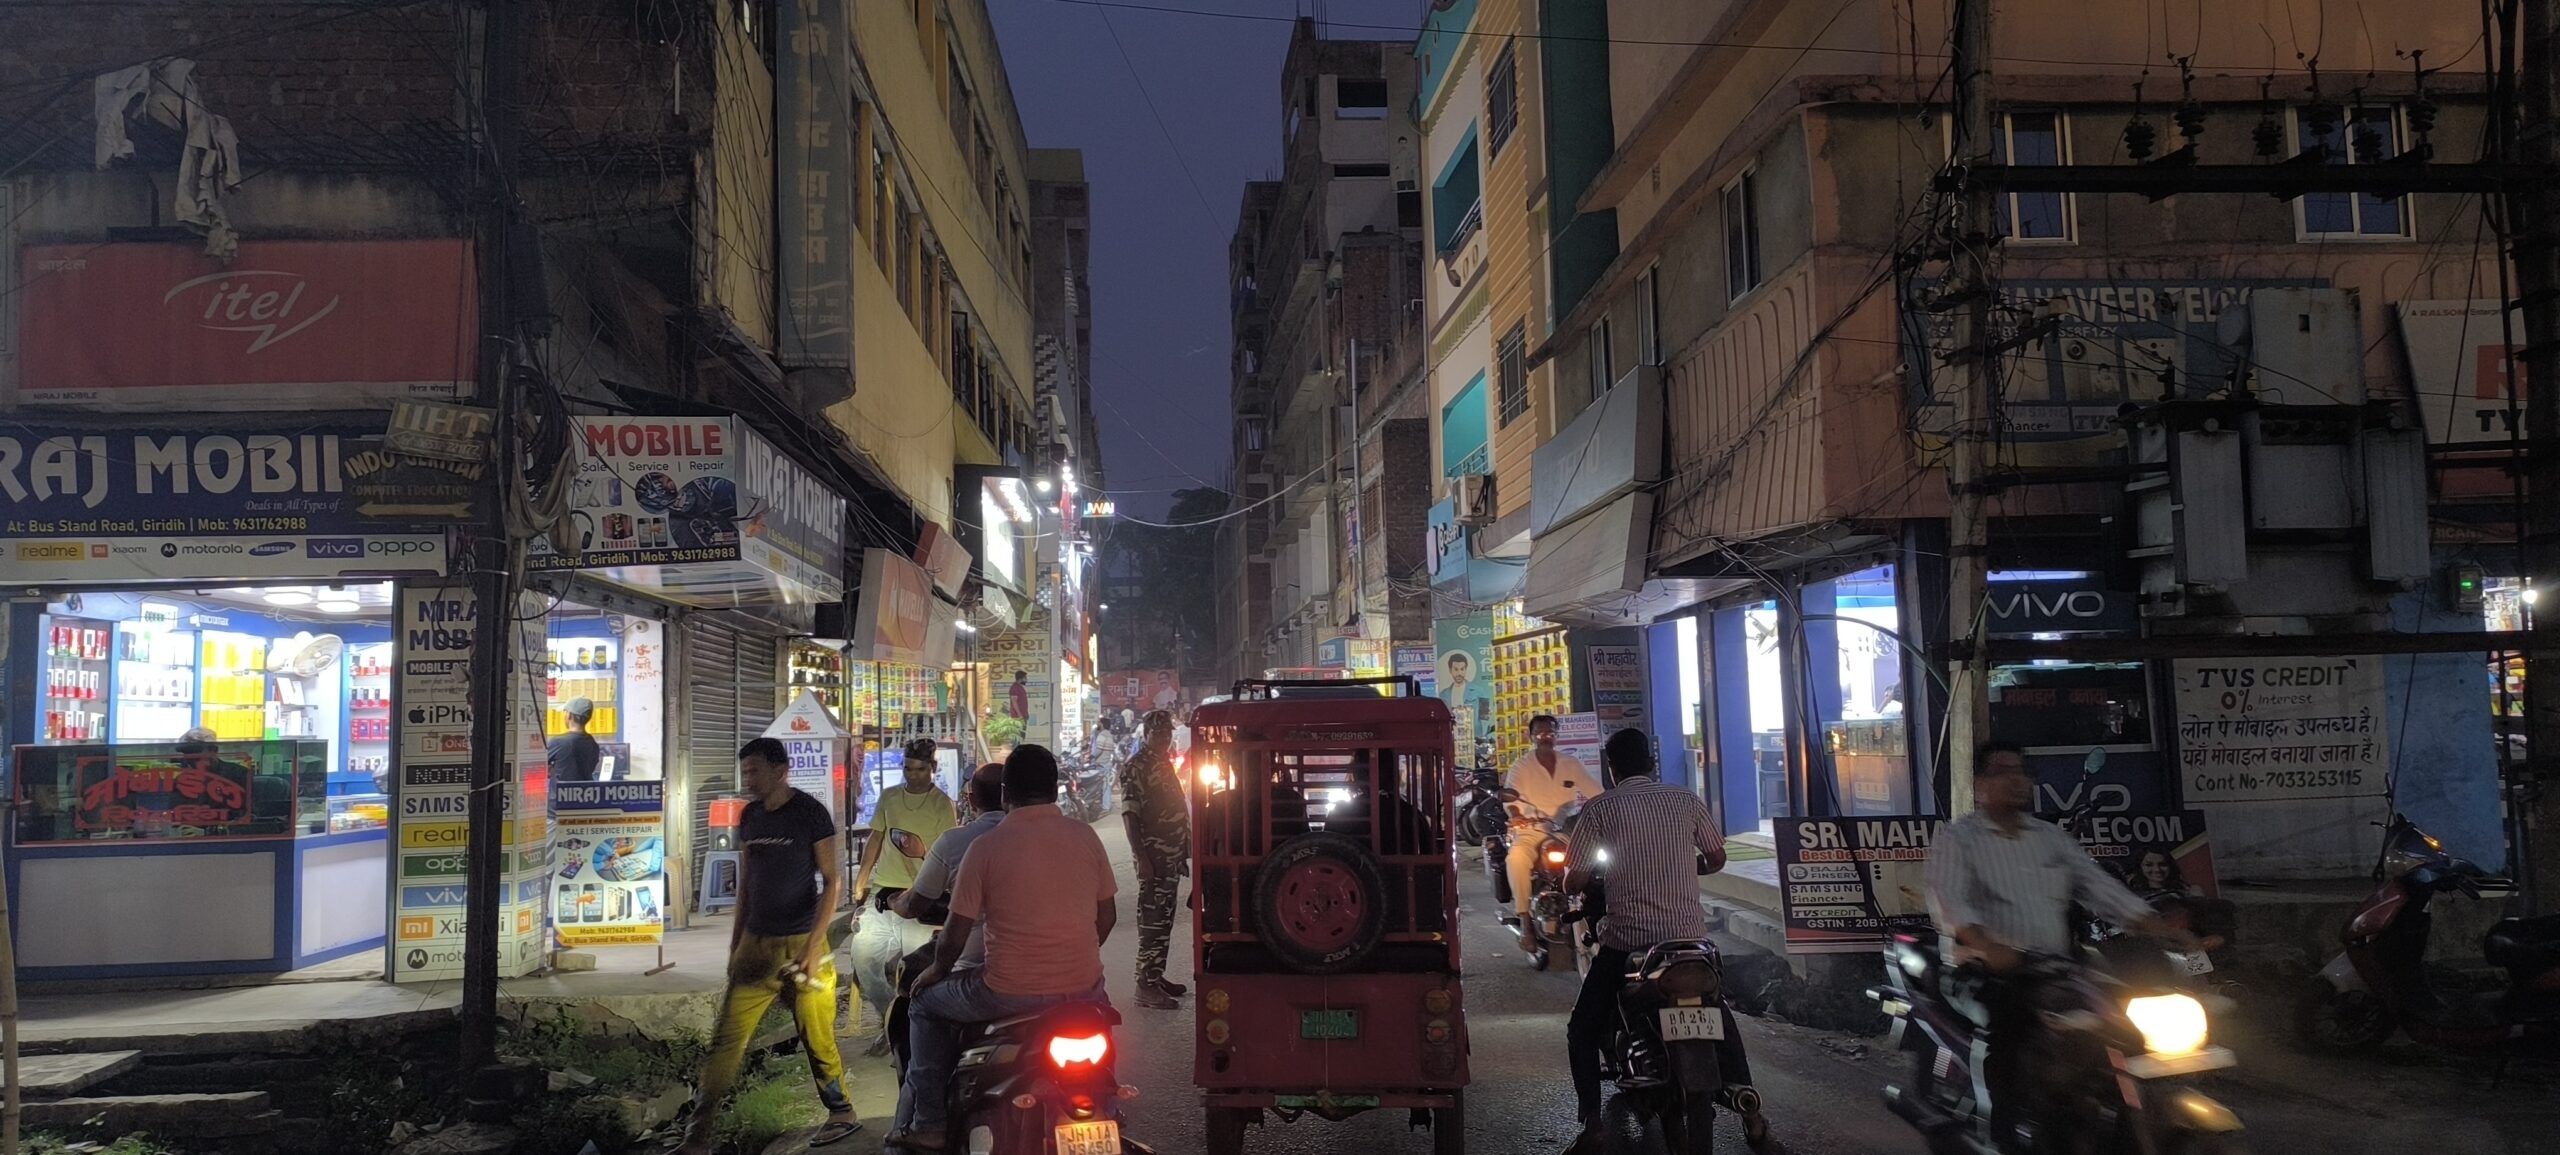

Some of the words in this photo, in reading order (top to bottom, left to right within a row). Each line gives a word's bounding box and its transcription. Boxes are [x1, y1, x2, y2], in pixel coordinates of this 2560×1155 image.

[204, 281, 305, 320] itel
[34, 392, 60, 400] NIRAJ
[63, 391, 97, 400] MOBILE
[395, 403, 490, 439] IIHT
[2003, 419, 2051, 431] inance+
[586, 425, 723, 456] MOBILE
[0, 436, 107, 509] RAJ
[135, 435, 343, 494] MOBIL
[344, 451, 395, 480] INDO
[581, 462, 607, 472] Sale
[628, 461, 669, 472] Service
[690, 461, 724, 472] Repair
[745, 431, 791, 525] NIRAJ
[793, 471, 838, 543] MOBILE
[245, 498, 272, 511] Deals
[273, 500, 282, 510] in
[302, 499, 326, 514] Types
[7, 520, 25, 532] At:
[29, 520, 54, 532] Bus
[59, 519, 96, 532] Stand
[102, 519, 138, 533] Road,
[142, 519, 186, 532] Giridih
[198, 518, 229, 531] Mob:
[232, 517, 308, 530] 9631762988
[22, 545, 78, 557] realme
[112, 544, 147, 554] xiaomi
[182, 543, 243, 555] motorola
[313, 542, 358, 554] vivo
[367, 541, 435, 556] oppo
[590, 555, 629, 565] Giridih
[641, 552, 668, 562] Mob:
[672, 548, 736, 561] 9631762988
[1986, 584, 2105, 618] vivo
[418, 600, 478, 621] NIRA
[979, 634, 1045, 651] राजेश
[1594, 648, 1605, 666] श्री
[1607, 648, 1637, 666] महावीर
[410, 662, 450, 674] MOBILE
[2198, 668, 2255, 687] TVS
[2262, 666, 2349, 686] CREDIT
[2221, 689, 2253, 713] 0%
[2258, 694, 2313, 705] Interest
[429, 705, 511, 724] iPhe
[2181, 714, 2214, 741] लोन
[2218, 714, 2228, 737] पे
[788, 755, 828, 768] OBILE
[415, 767, 473, 783] NOTH
[2195, 773, 2234, 791] Cont
[558, 787, 600, 803] NIRAJ
[606, 785, 660, 800] MOBILE
[2033, 782, 2131, 812] ivo
[405, 796, 510, 814] SAMSG
[590, 827, 621, 835] SERVICE
[1801, 850, 1833, 861] Best
[1834, 850, 1875, 860] Deals
[1894, 848, 1929, 859] Mobi
[426, 858, 469, 871] opp
[426, 887, 468, 903] viv
[1790, 884, 1862, 893] SAMSUNG
[1794, 909, 1820, 917] TVS
[440, 917, 505, 934] Xiai
[1807, 920, 1844, 928] GSTIN
[1670, 1025, 1714, 1036] 0312
[1067, 1126, 1111, 1142] JH11A
